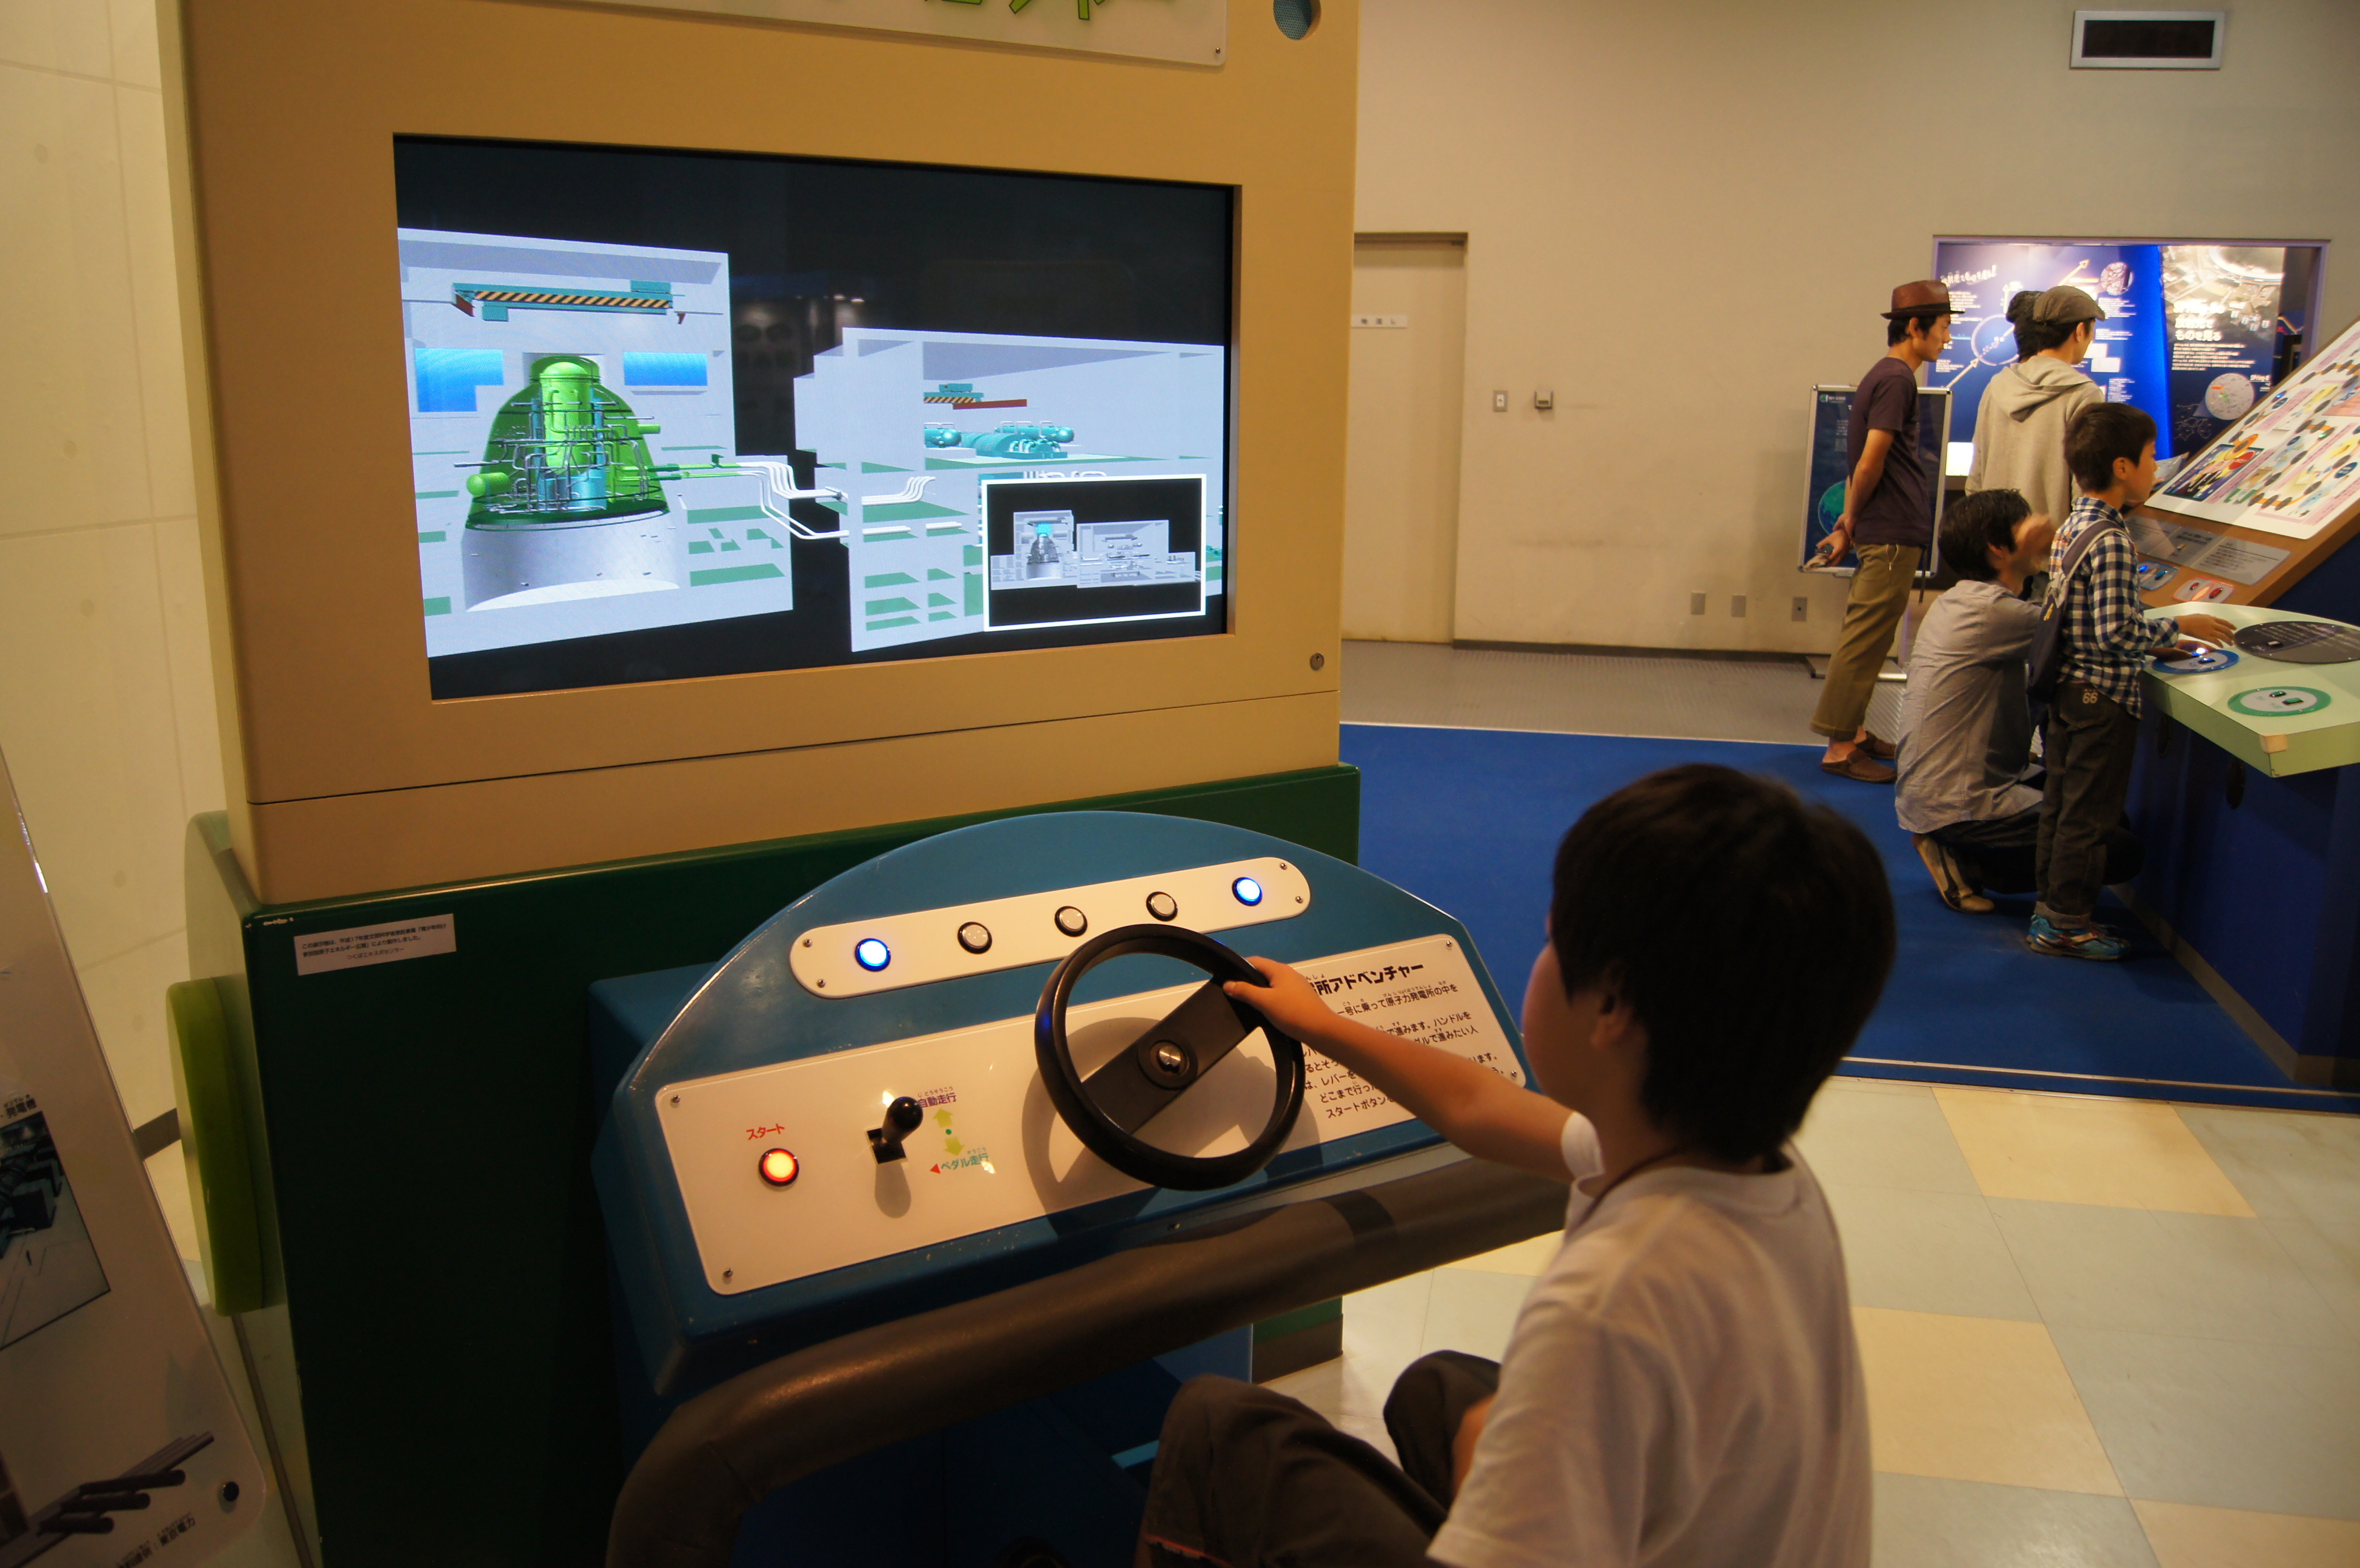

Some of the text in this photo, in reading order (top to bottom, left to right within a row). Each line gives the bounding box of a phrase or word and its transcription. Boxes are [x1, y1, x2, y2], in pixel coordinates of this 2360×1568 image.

[2175, 330, 2222, 341] ものを見る
[1309, 964, 1424, 996] 所アドベンチャー
[918, 1092, 957, 1109] 自動走行
[746, 1123, 786, 1140] スタート
